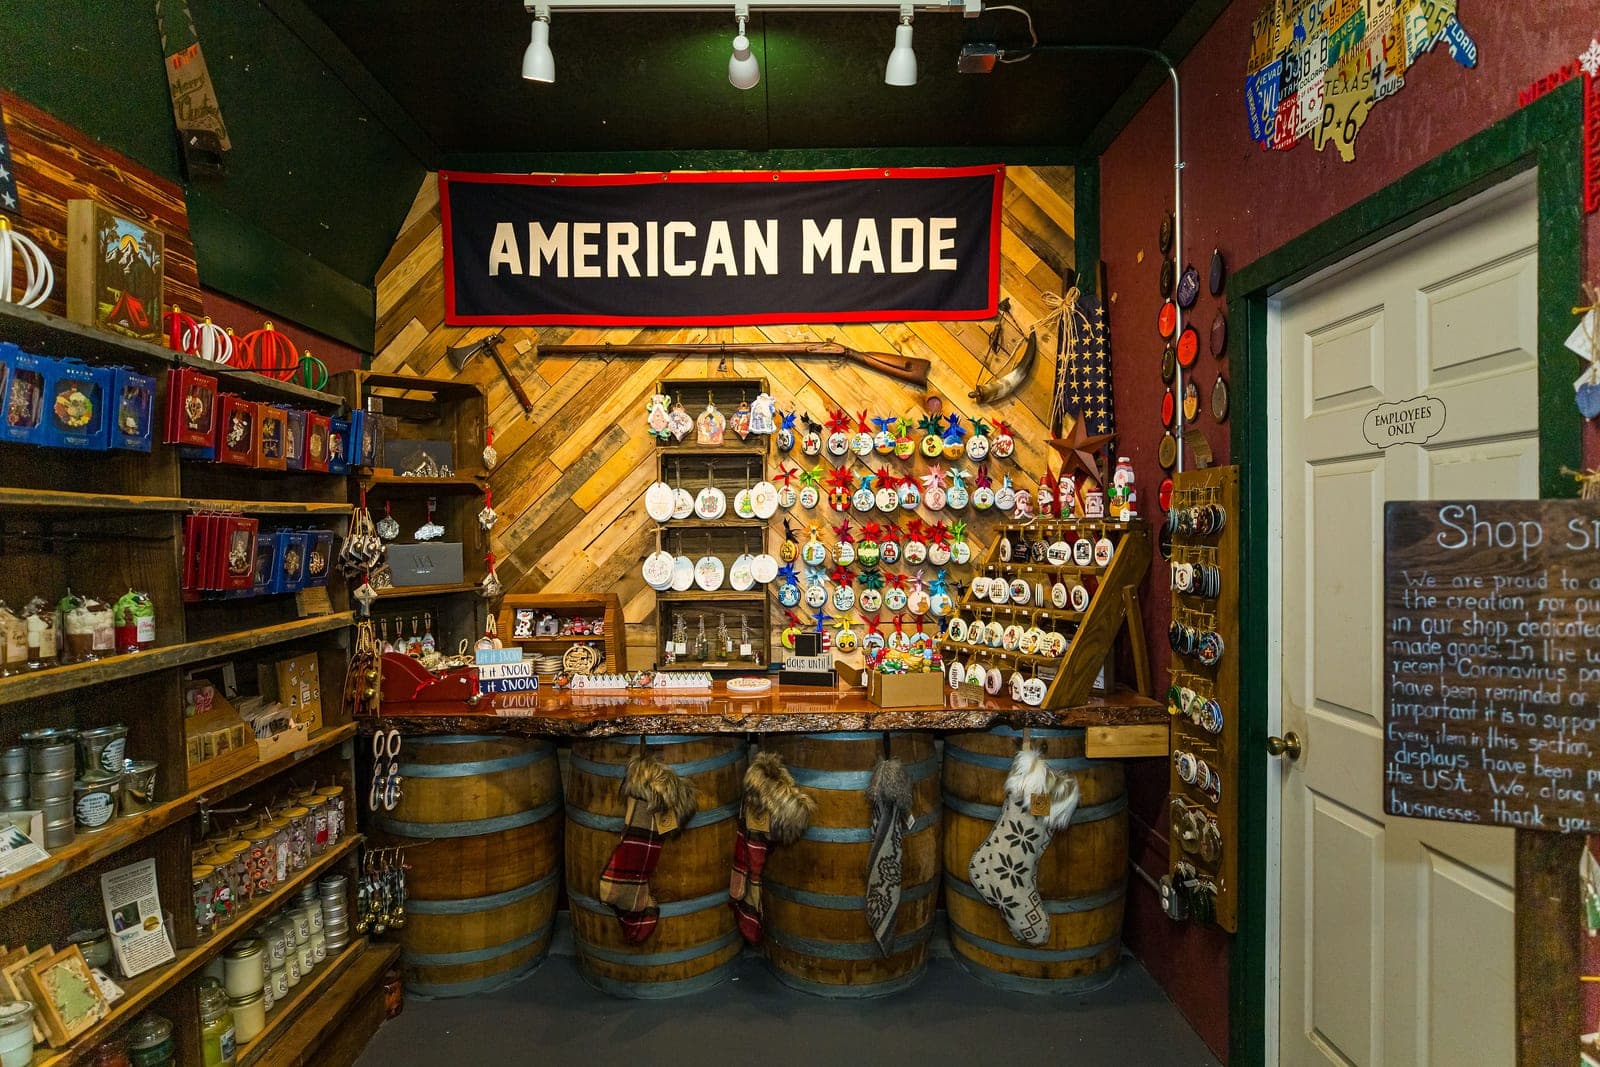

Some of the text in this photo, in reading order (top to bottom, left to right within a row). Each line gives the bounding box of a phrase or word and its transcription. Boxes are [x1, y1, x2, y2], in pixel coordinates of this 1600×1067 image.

[1278, 80, 1300, 102] UTAH
[1324, 71, 1371, 97] TEXAS
[1373, 78, 1404, 103] LOUIS
[488, 217, 958, 278] AMERICAN MADE
[1375, 406, 1432, 427] EMPLOYEES
[1388, 422, 1416, 437] ONLY
[1436, 505, 1543, 561] Shop
[1402, 570, 1437, 588] We
[1452, 576, 1483, 589] are
[1493, 568, 1548, 594] proud
[1560, 568, 1579, 591] to
[1402, 588, 1437, 609] the
[1446, 591, 1524, 611] creation
[1392, 616, 1411, 633] in
[1421, 617, 1454, 635] our
[1463, 611, 1508, 645] shop
[1391, 635, 1442, 656] made
[1505, 638, 1534, 660] In
[501, 664, 530, 677] SNOW
[1392, 655, 1447, 674] recent
[1457, 657, 1568, 683] Coronavirus
[487, 680, 497, 693] it
[501, 677, 538, 692] SNOW
[1391, 673, 1434, 697] have
[1440, 675, 1478, 699] been
[1484, 681, 1561, 705] reminded
[1391, 697, 1479, 725] important
[1484, 700, 1497, 722] it
[1502, 707, 1515, 724] is
[1518, 703, 1537, 727] to
[1388, 721, 1430, 749] Every
[1436, 722, 1467, 746] item
[1487, 726, 1519, 750] this
[1386, 762, 1414, 784] the
[1394, 741, 1469, 771] displays
[1482, 747, 1526, 774] have
[1534, 753, 1573, 779] been
[1391, 786, 1591, 834] businesses thank you
